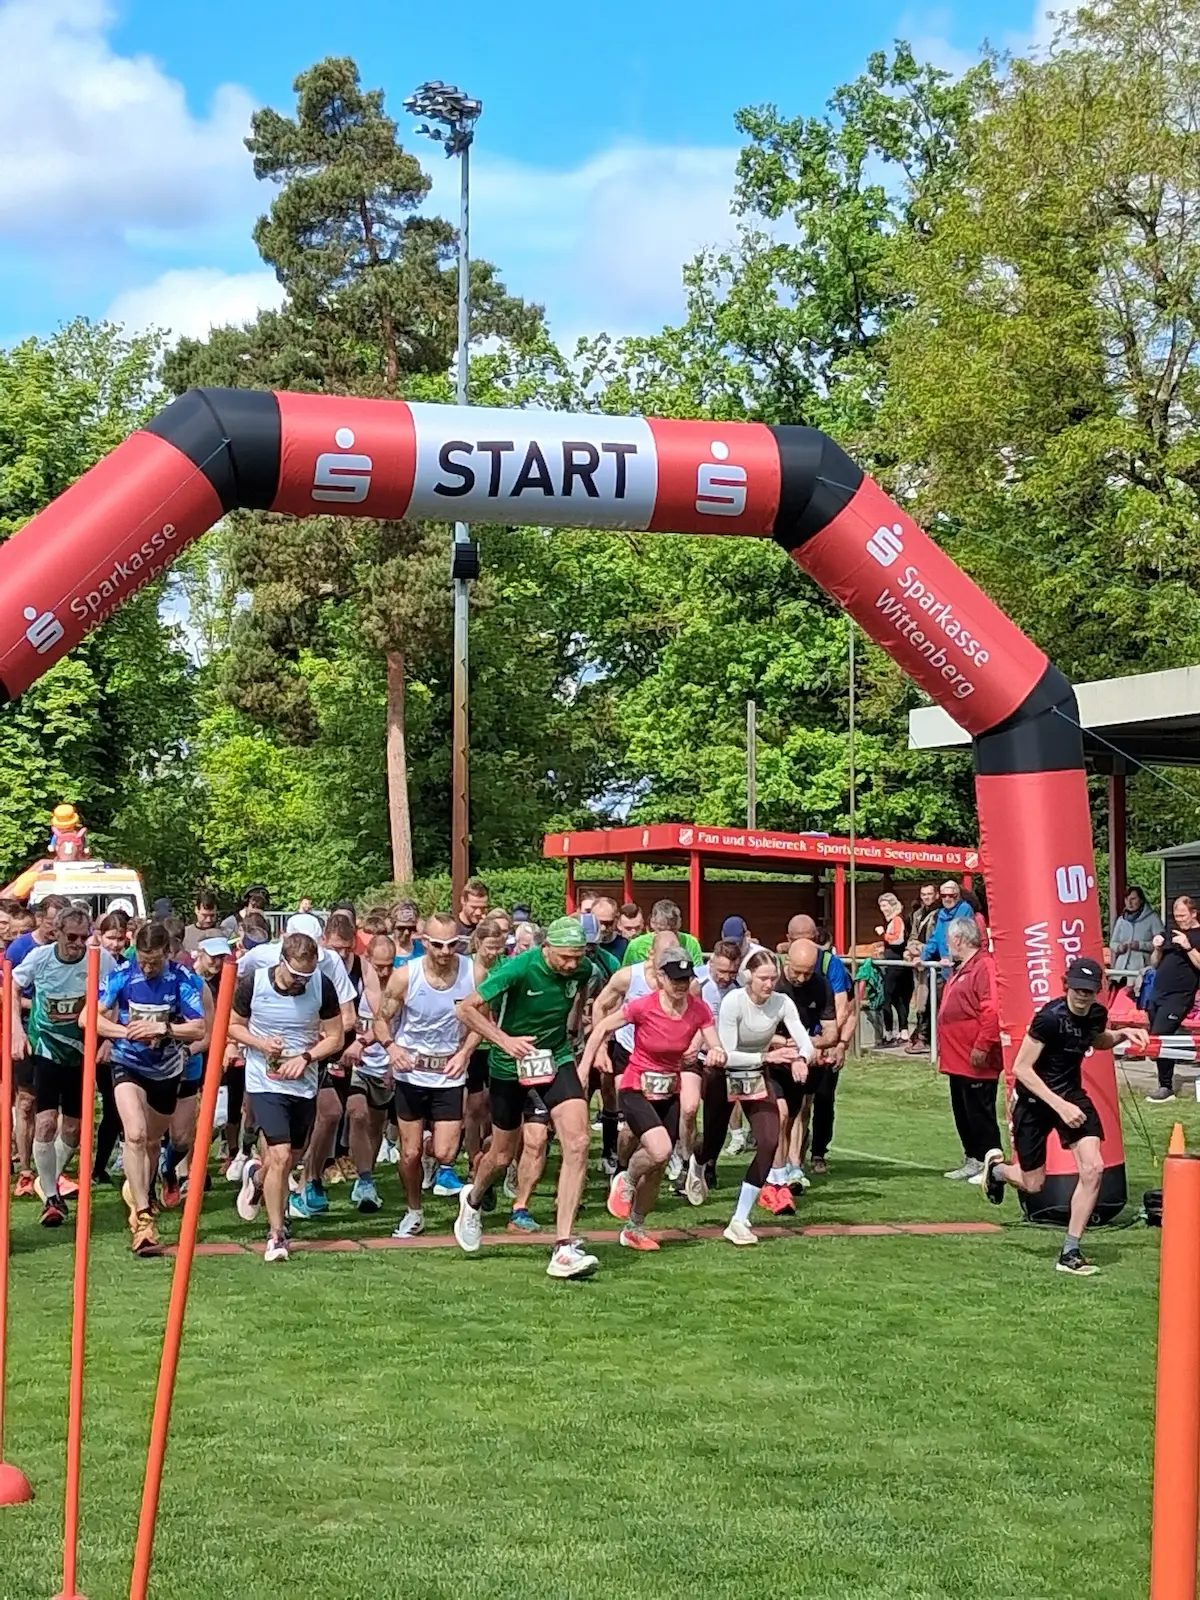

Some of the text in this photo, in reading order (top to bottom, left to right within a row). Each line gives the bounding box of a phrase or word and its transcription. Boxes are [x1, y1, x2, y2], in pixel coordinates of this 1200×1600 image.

[433, 440, 638, 499] START
[70, 523, 178, 621] Sparkasse
[897, 566, 990, 668] Sparkasse
[875, 588, 976, 700] Wittenberg
[698, 831, 719, 844] Fan
[722, 835, 745, 847] und
[1023, 921, 1051, 1013] Witten
[524, 1057, 553, 1077] 124
